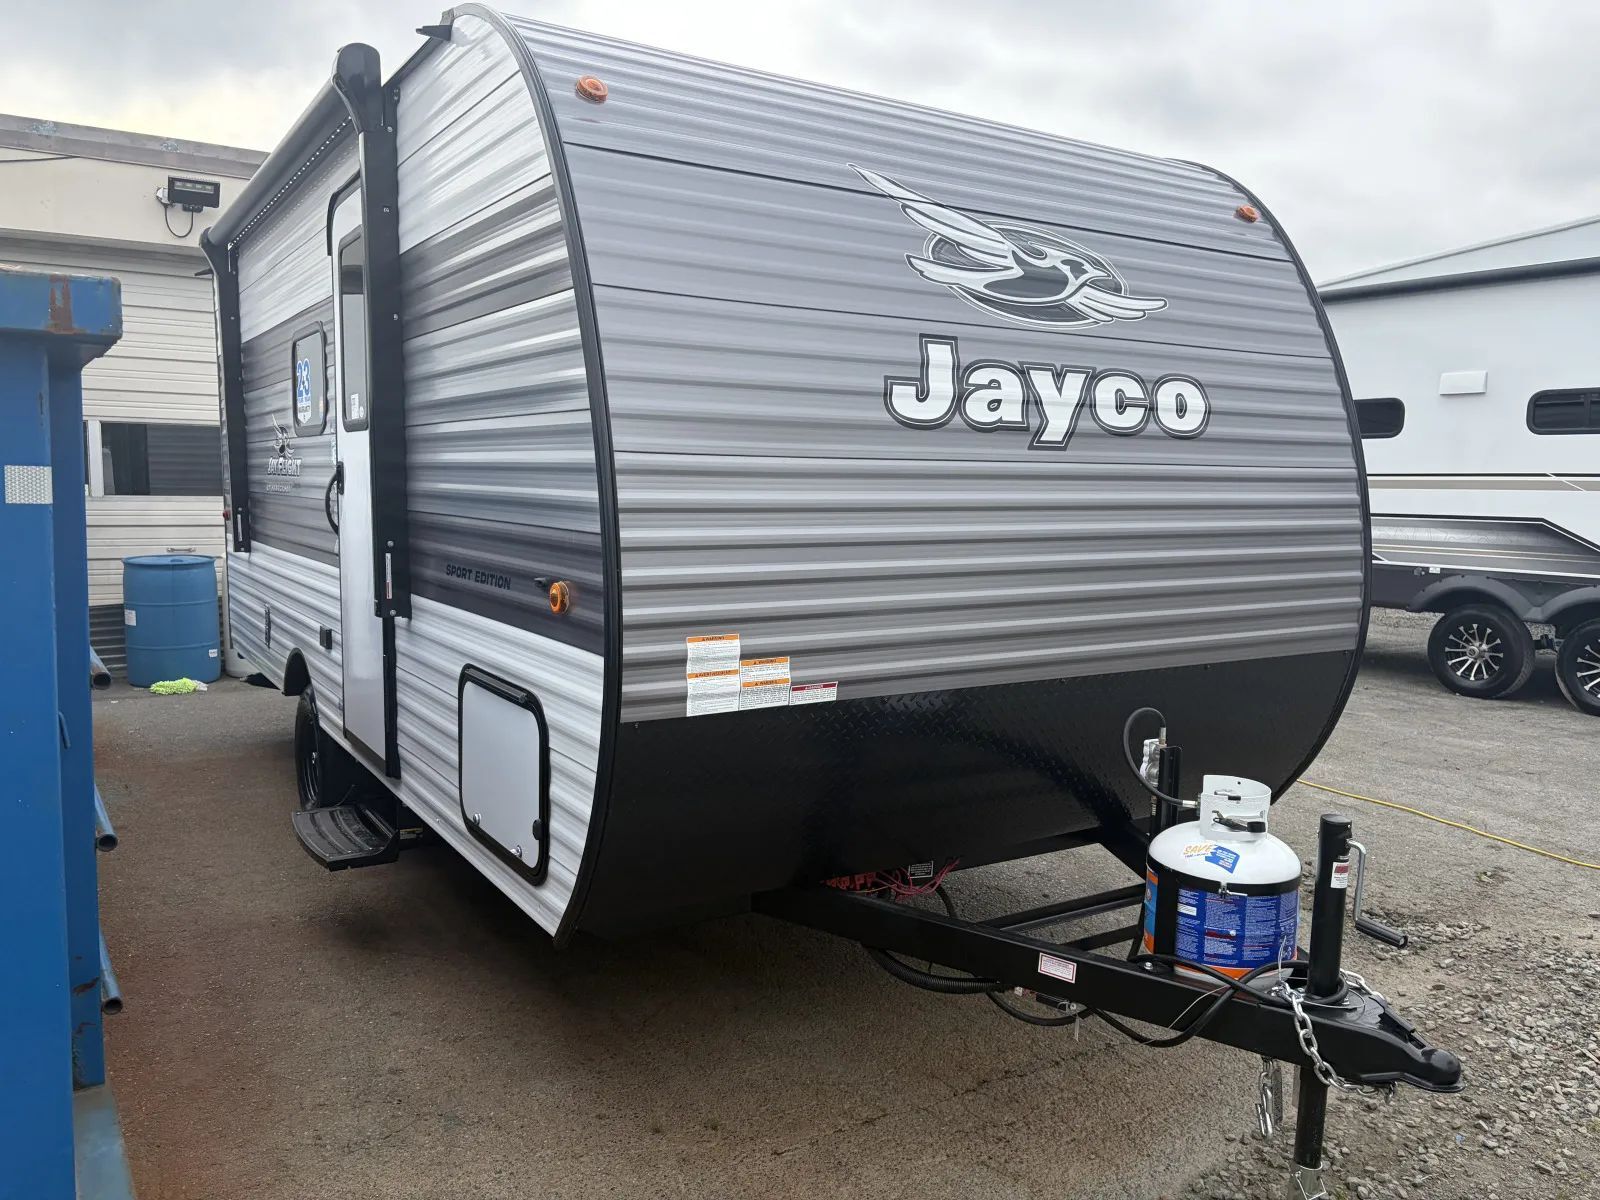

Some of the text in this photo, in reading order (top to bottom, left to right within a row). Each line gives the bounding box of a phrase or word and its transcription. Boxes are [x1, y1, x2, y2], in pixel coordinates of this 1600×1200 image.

[884, 333, 1211, 451] Jayco
[278, 457, 302, 476] FLIGHT
[446, 564, 512, 590] SPORT EDITION
[1183, 843, 1213, 855] SAVE
